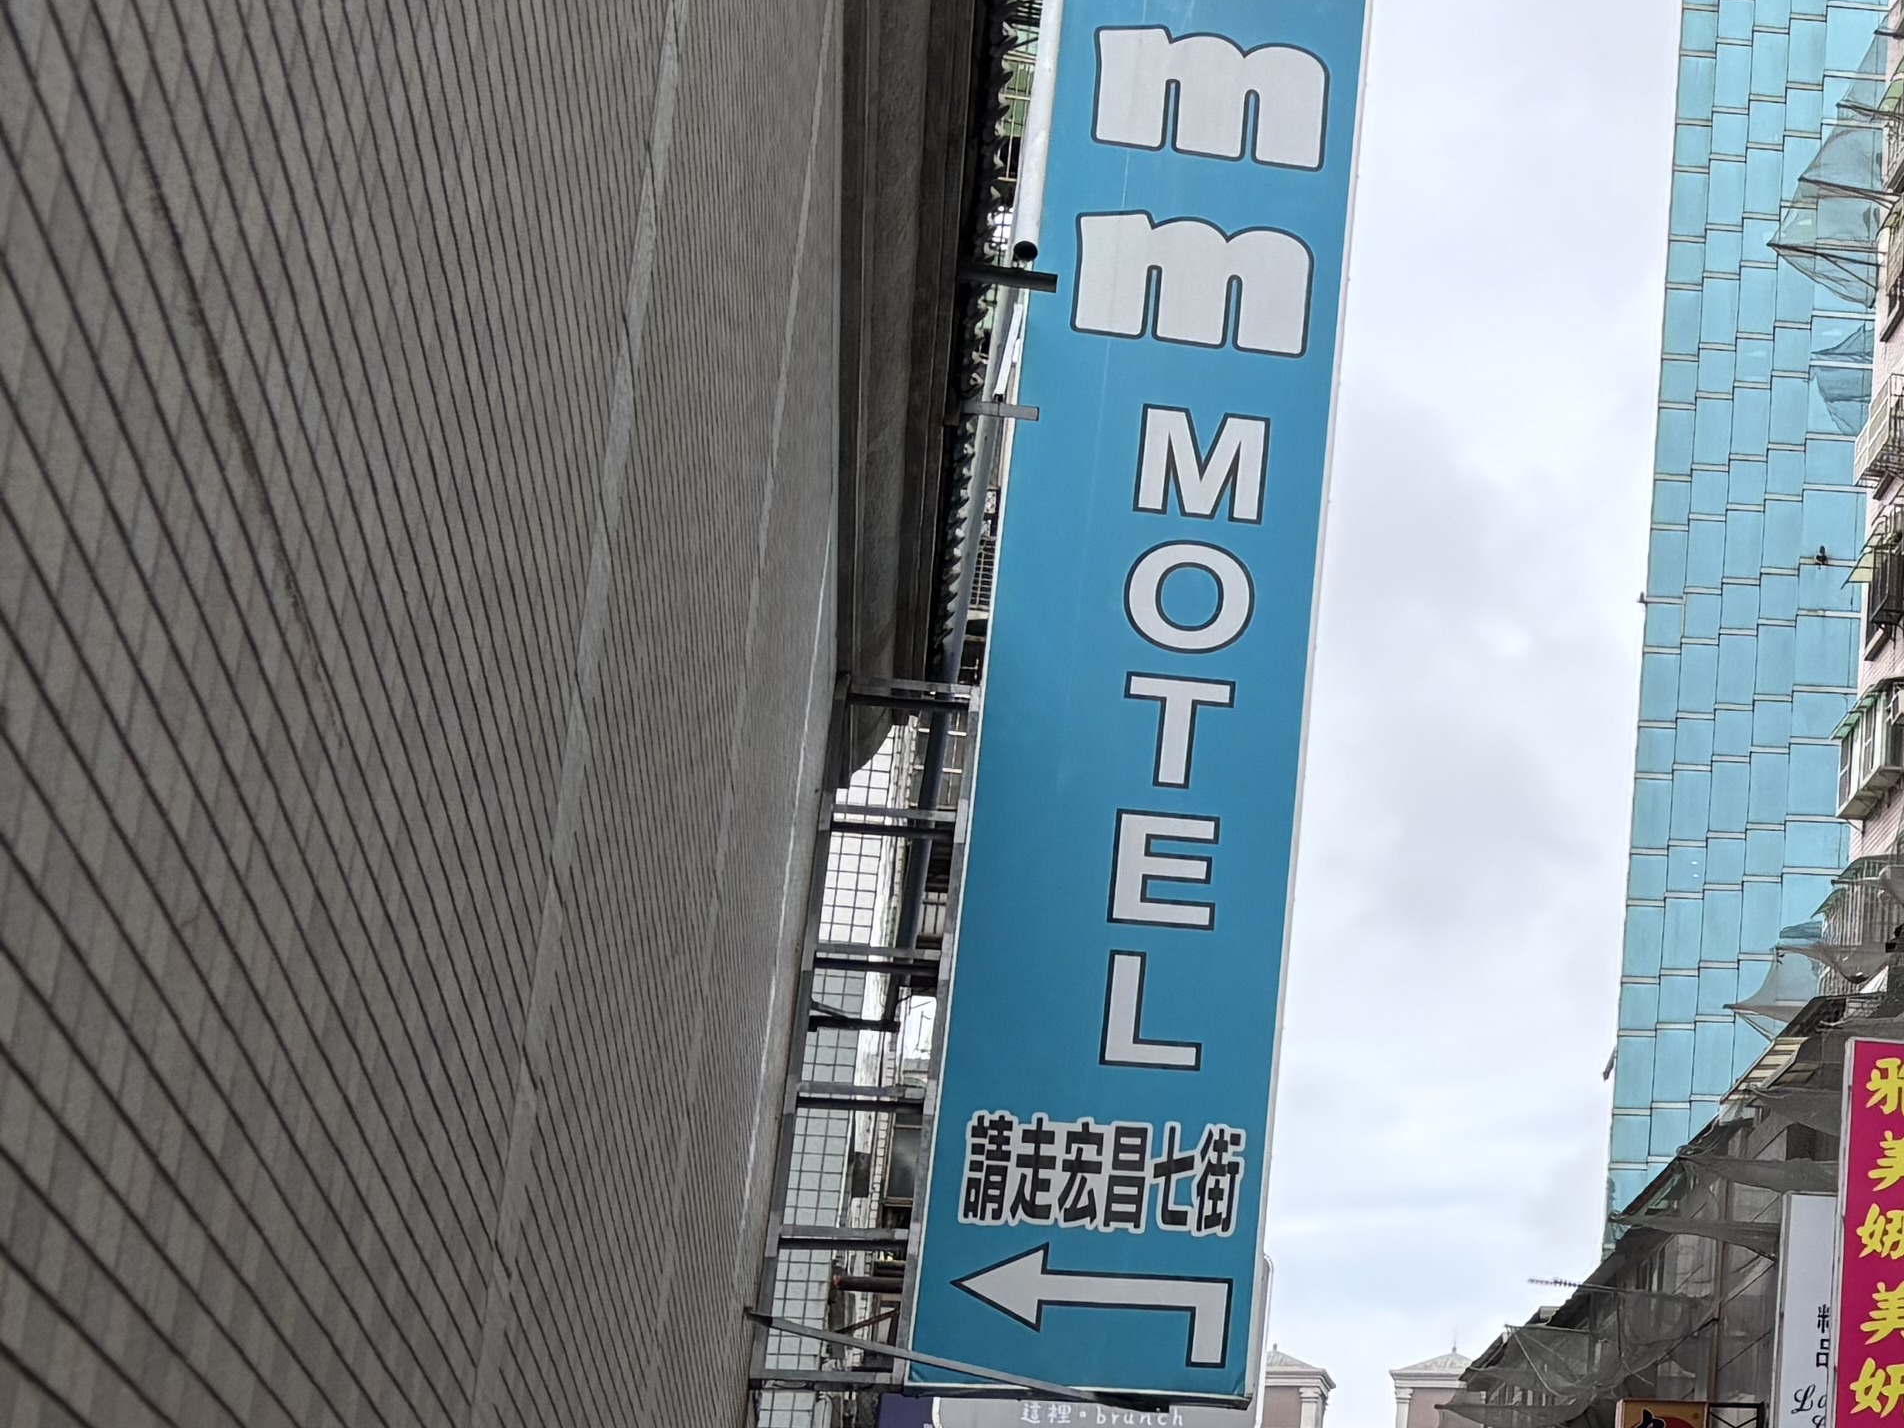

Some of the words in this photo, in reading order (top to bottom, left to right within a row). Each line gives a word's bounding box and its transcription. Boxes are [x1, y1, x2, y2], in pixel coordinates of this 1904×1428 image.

[1098, 403, 1271, 1070] MOTEL
[960, 1112, 1246, 1236] 請走宏昌七街
